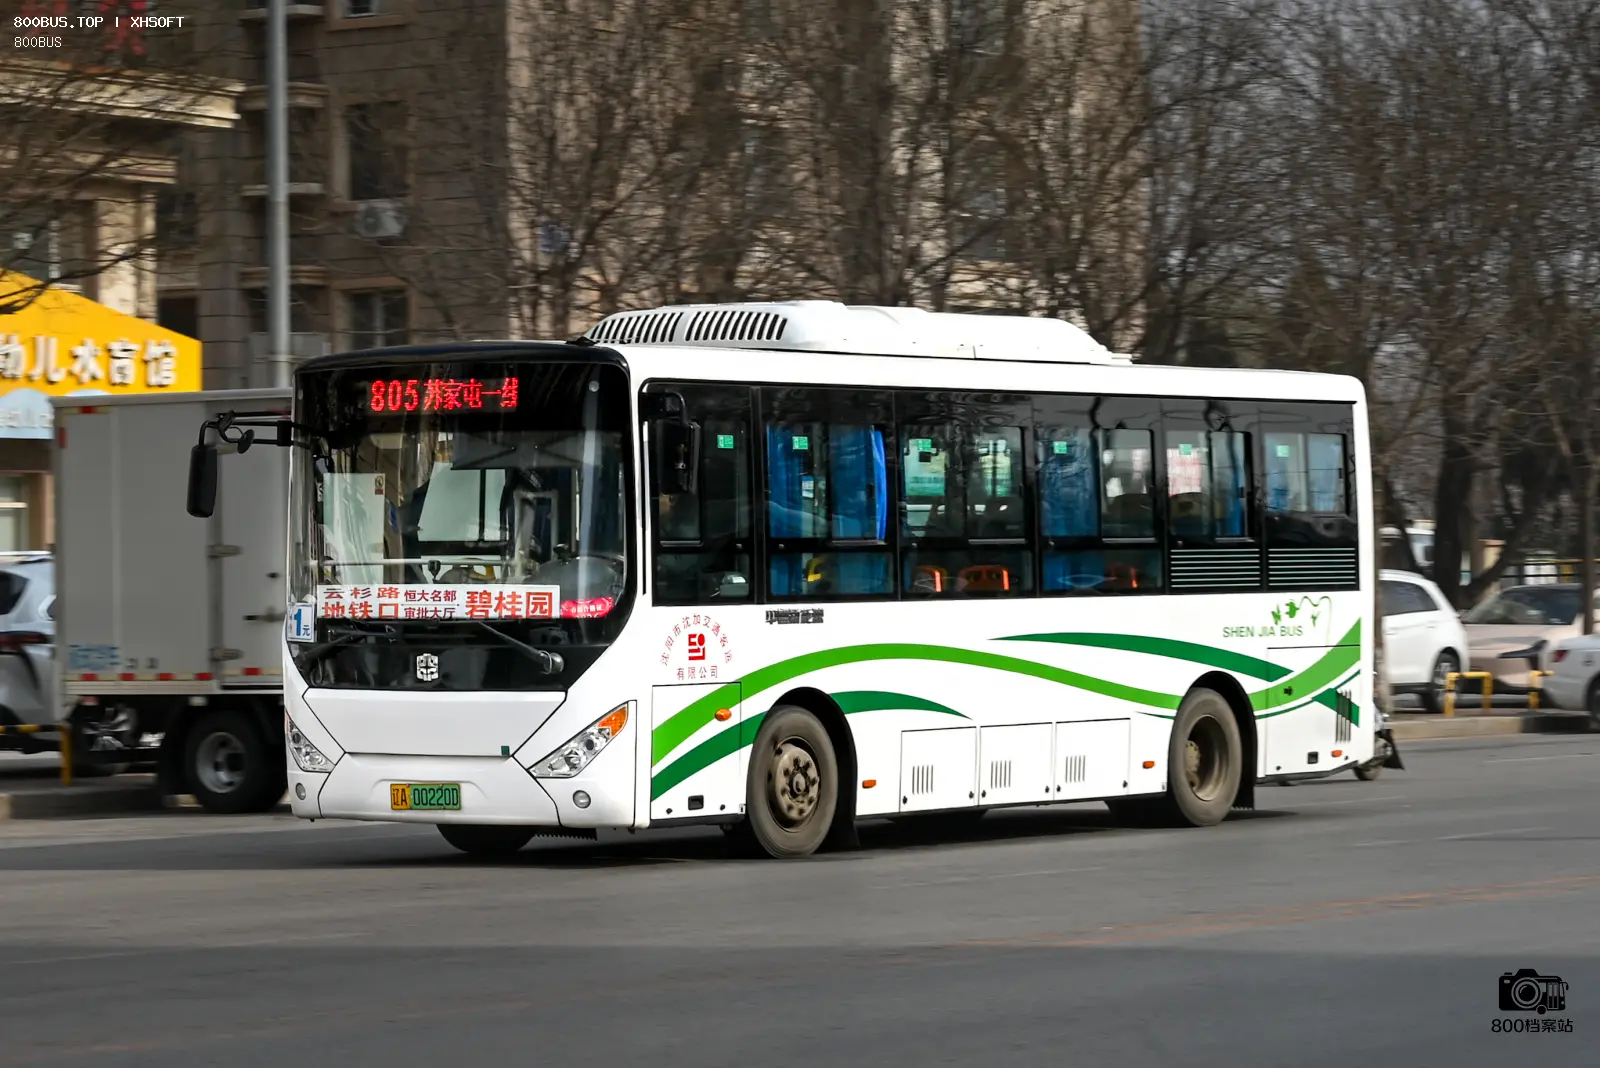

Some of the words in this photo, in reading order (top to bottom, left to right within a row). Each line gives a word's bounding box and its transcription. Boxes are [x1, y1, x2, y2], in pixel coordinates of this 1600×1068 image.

[371, 379, 419, 411] 805
[423, 377, 519, 411] 苏家屯一线
[323, 586, 400, 600] 云杉路
[403, 589, 457, 604] 恒大名都
[322, 601, 399, 619] 地铁口
[465, 590, 553, 619] 碧桂园
[403, 606, 457, 620] 审批大厅
[1222, 625, 1255, 638] SHEN
[1257, 625, 1277, 637] JIA
[1279, 624, 1304, 637] BUS
[676, 665, 718, 681] 有限公司
